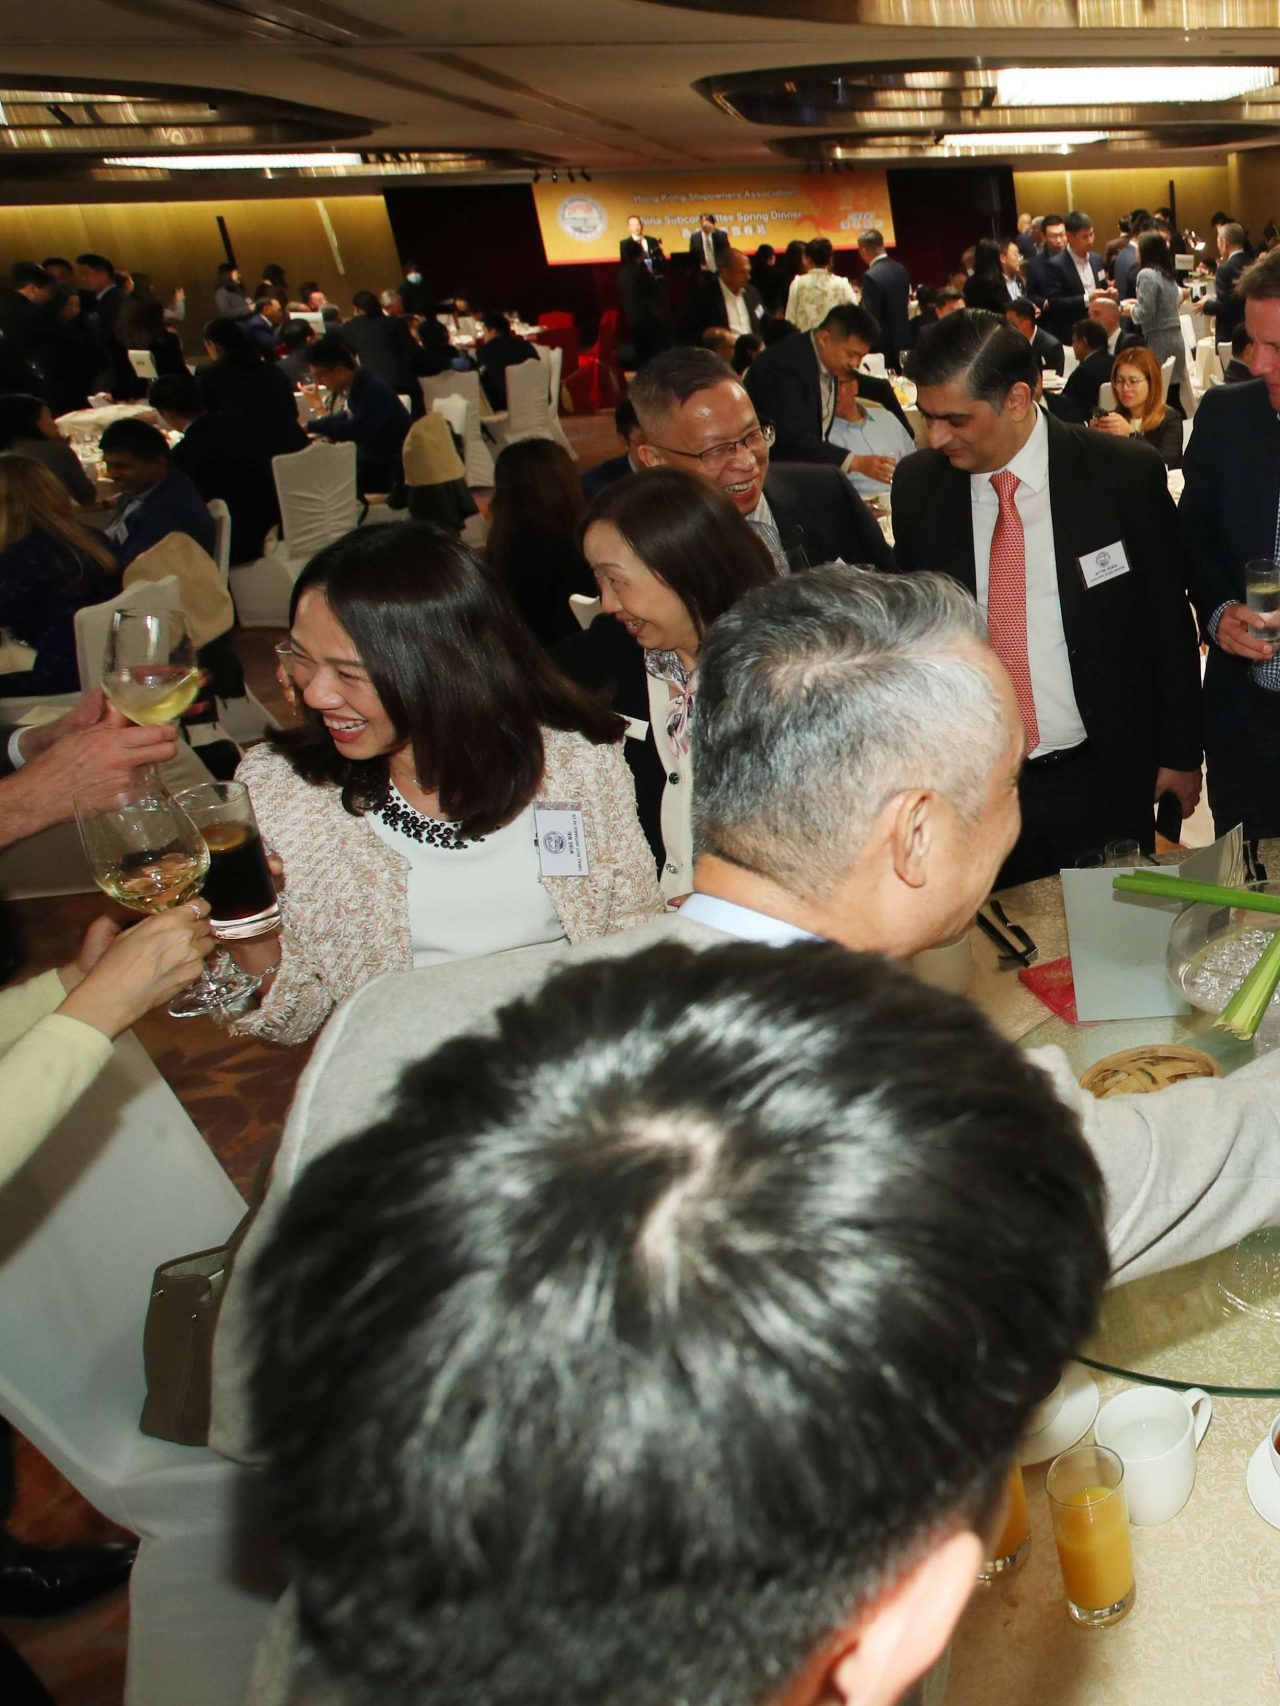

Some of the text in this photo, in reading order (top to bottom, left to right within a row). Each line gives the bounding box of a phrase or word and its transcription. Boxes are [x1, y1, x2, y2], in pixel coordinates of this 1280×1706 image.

[661, 193, 686, 203] Kong
[640, 215, 662, 225] hina
[736, 211, 769, 224] Spring
[770, 209, 802, 220] Dinner
